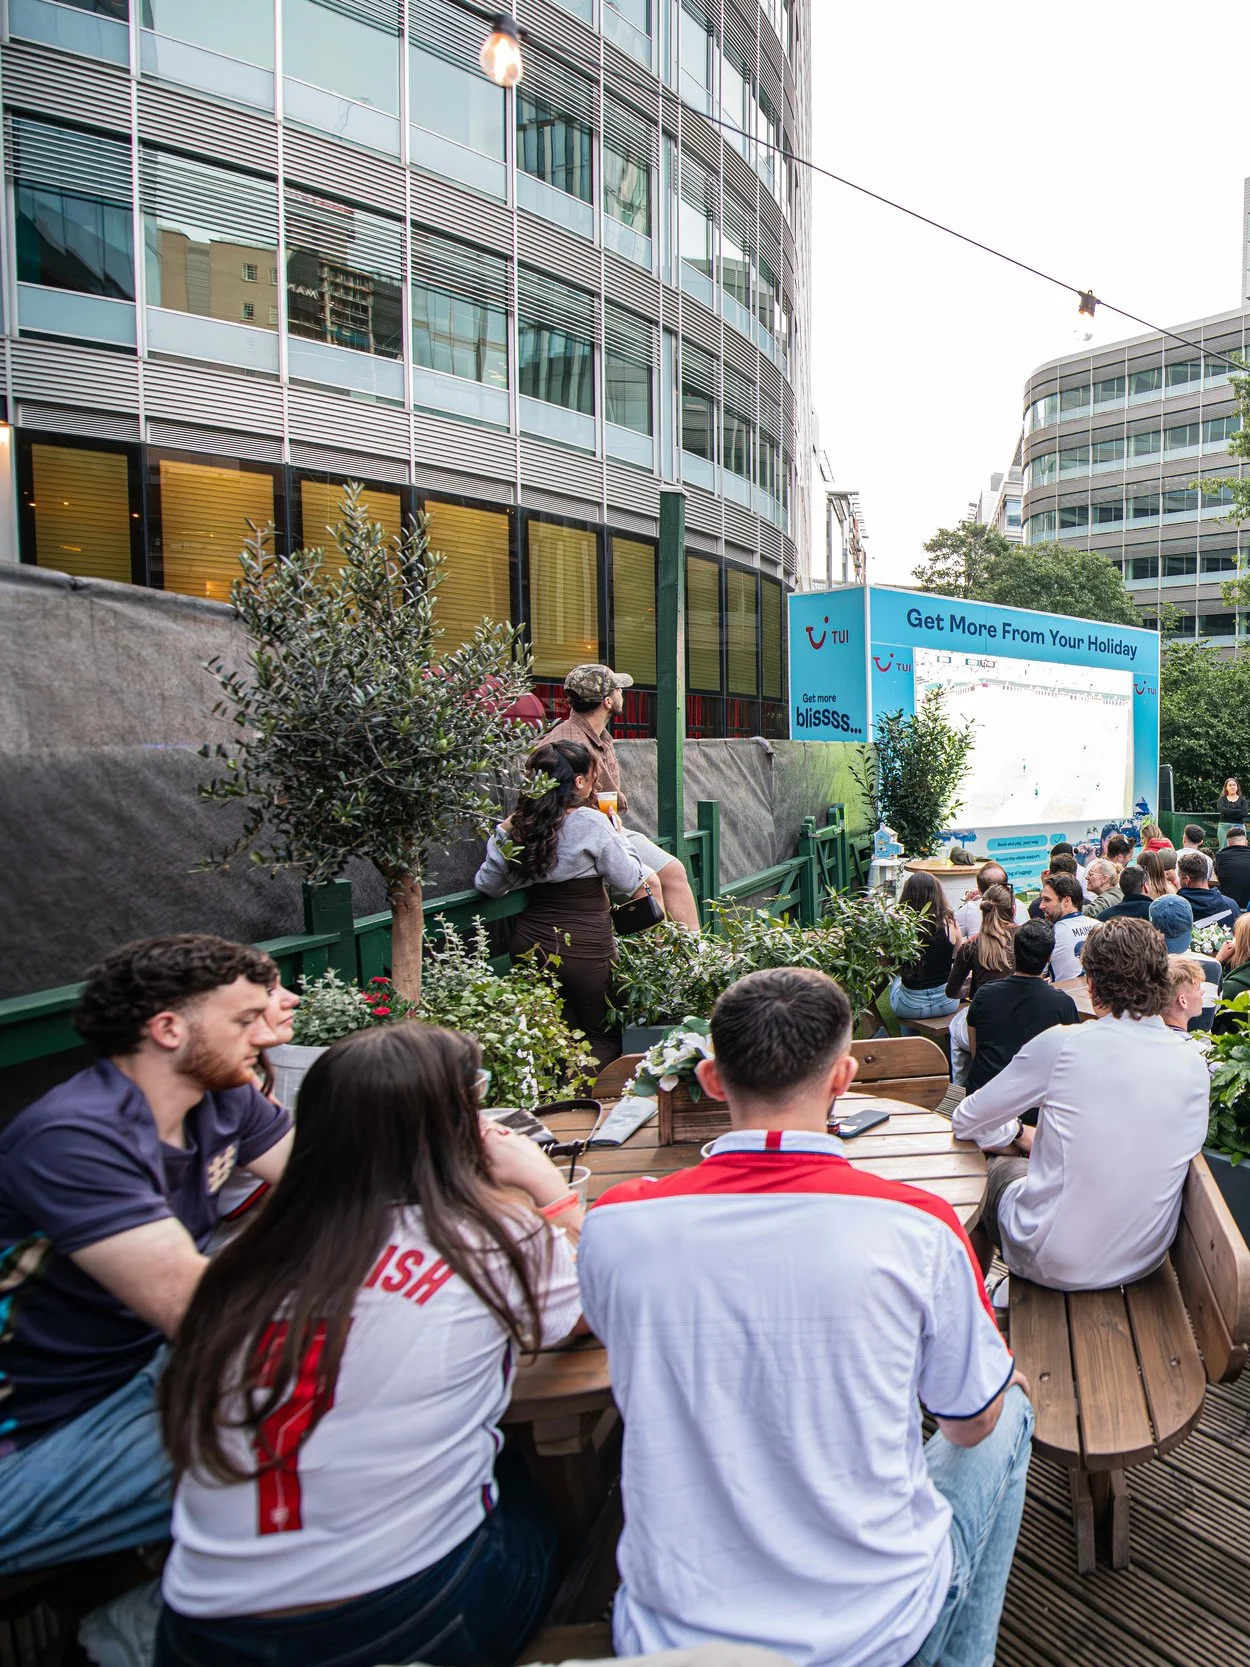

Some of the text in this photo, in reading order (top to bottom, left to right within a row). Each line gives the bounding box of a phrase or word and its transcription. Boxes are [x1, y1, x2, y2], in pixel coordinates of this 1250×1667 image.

[832, 630, 849, 645] TUI
[906, 608, 1138, 661] Get More From Your Holiday
[896, 662, 912, 672] TUI
[802, 693, 837, 703] Get more
